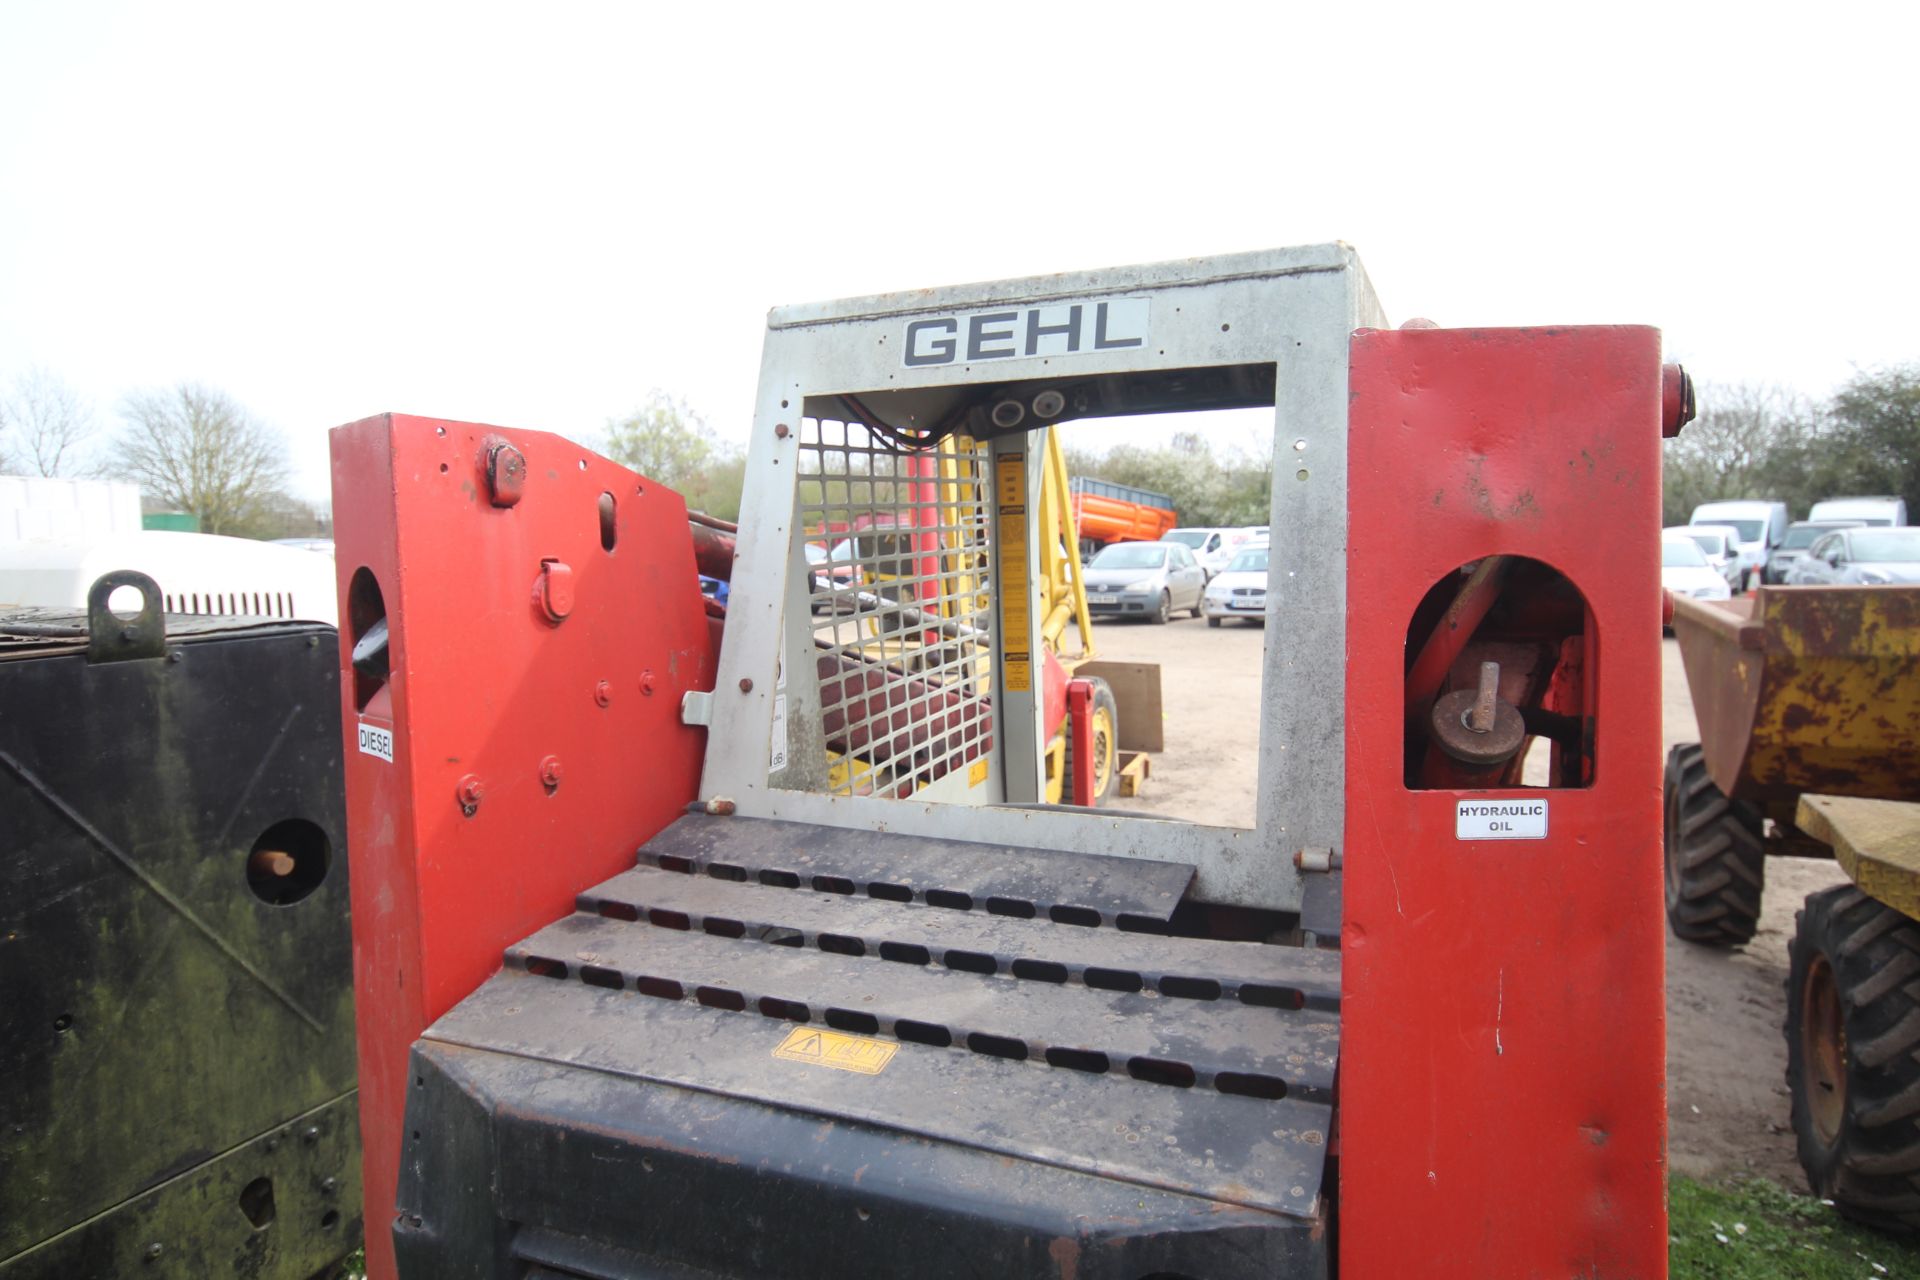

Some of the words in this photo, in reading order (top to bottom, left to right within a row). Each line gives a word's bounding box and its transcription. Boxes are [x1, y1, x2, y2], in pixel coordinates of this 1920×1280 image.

[904, 302, 1142, 366] GEHL
[360, 729, 392, 757] DIESEL
[1460, 806, 1543, 817] HYDRAULIC
[1489, 821, 1513, 831] OIL
